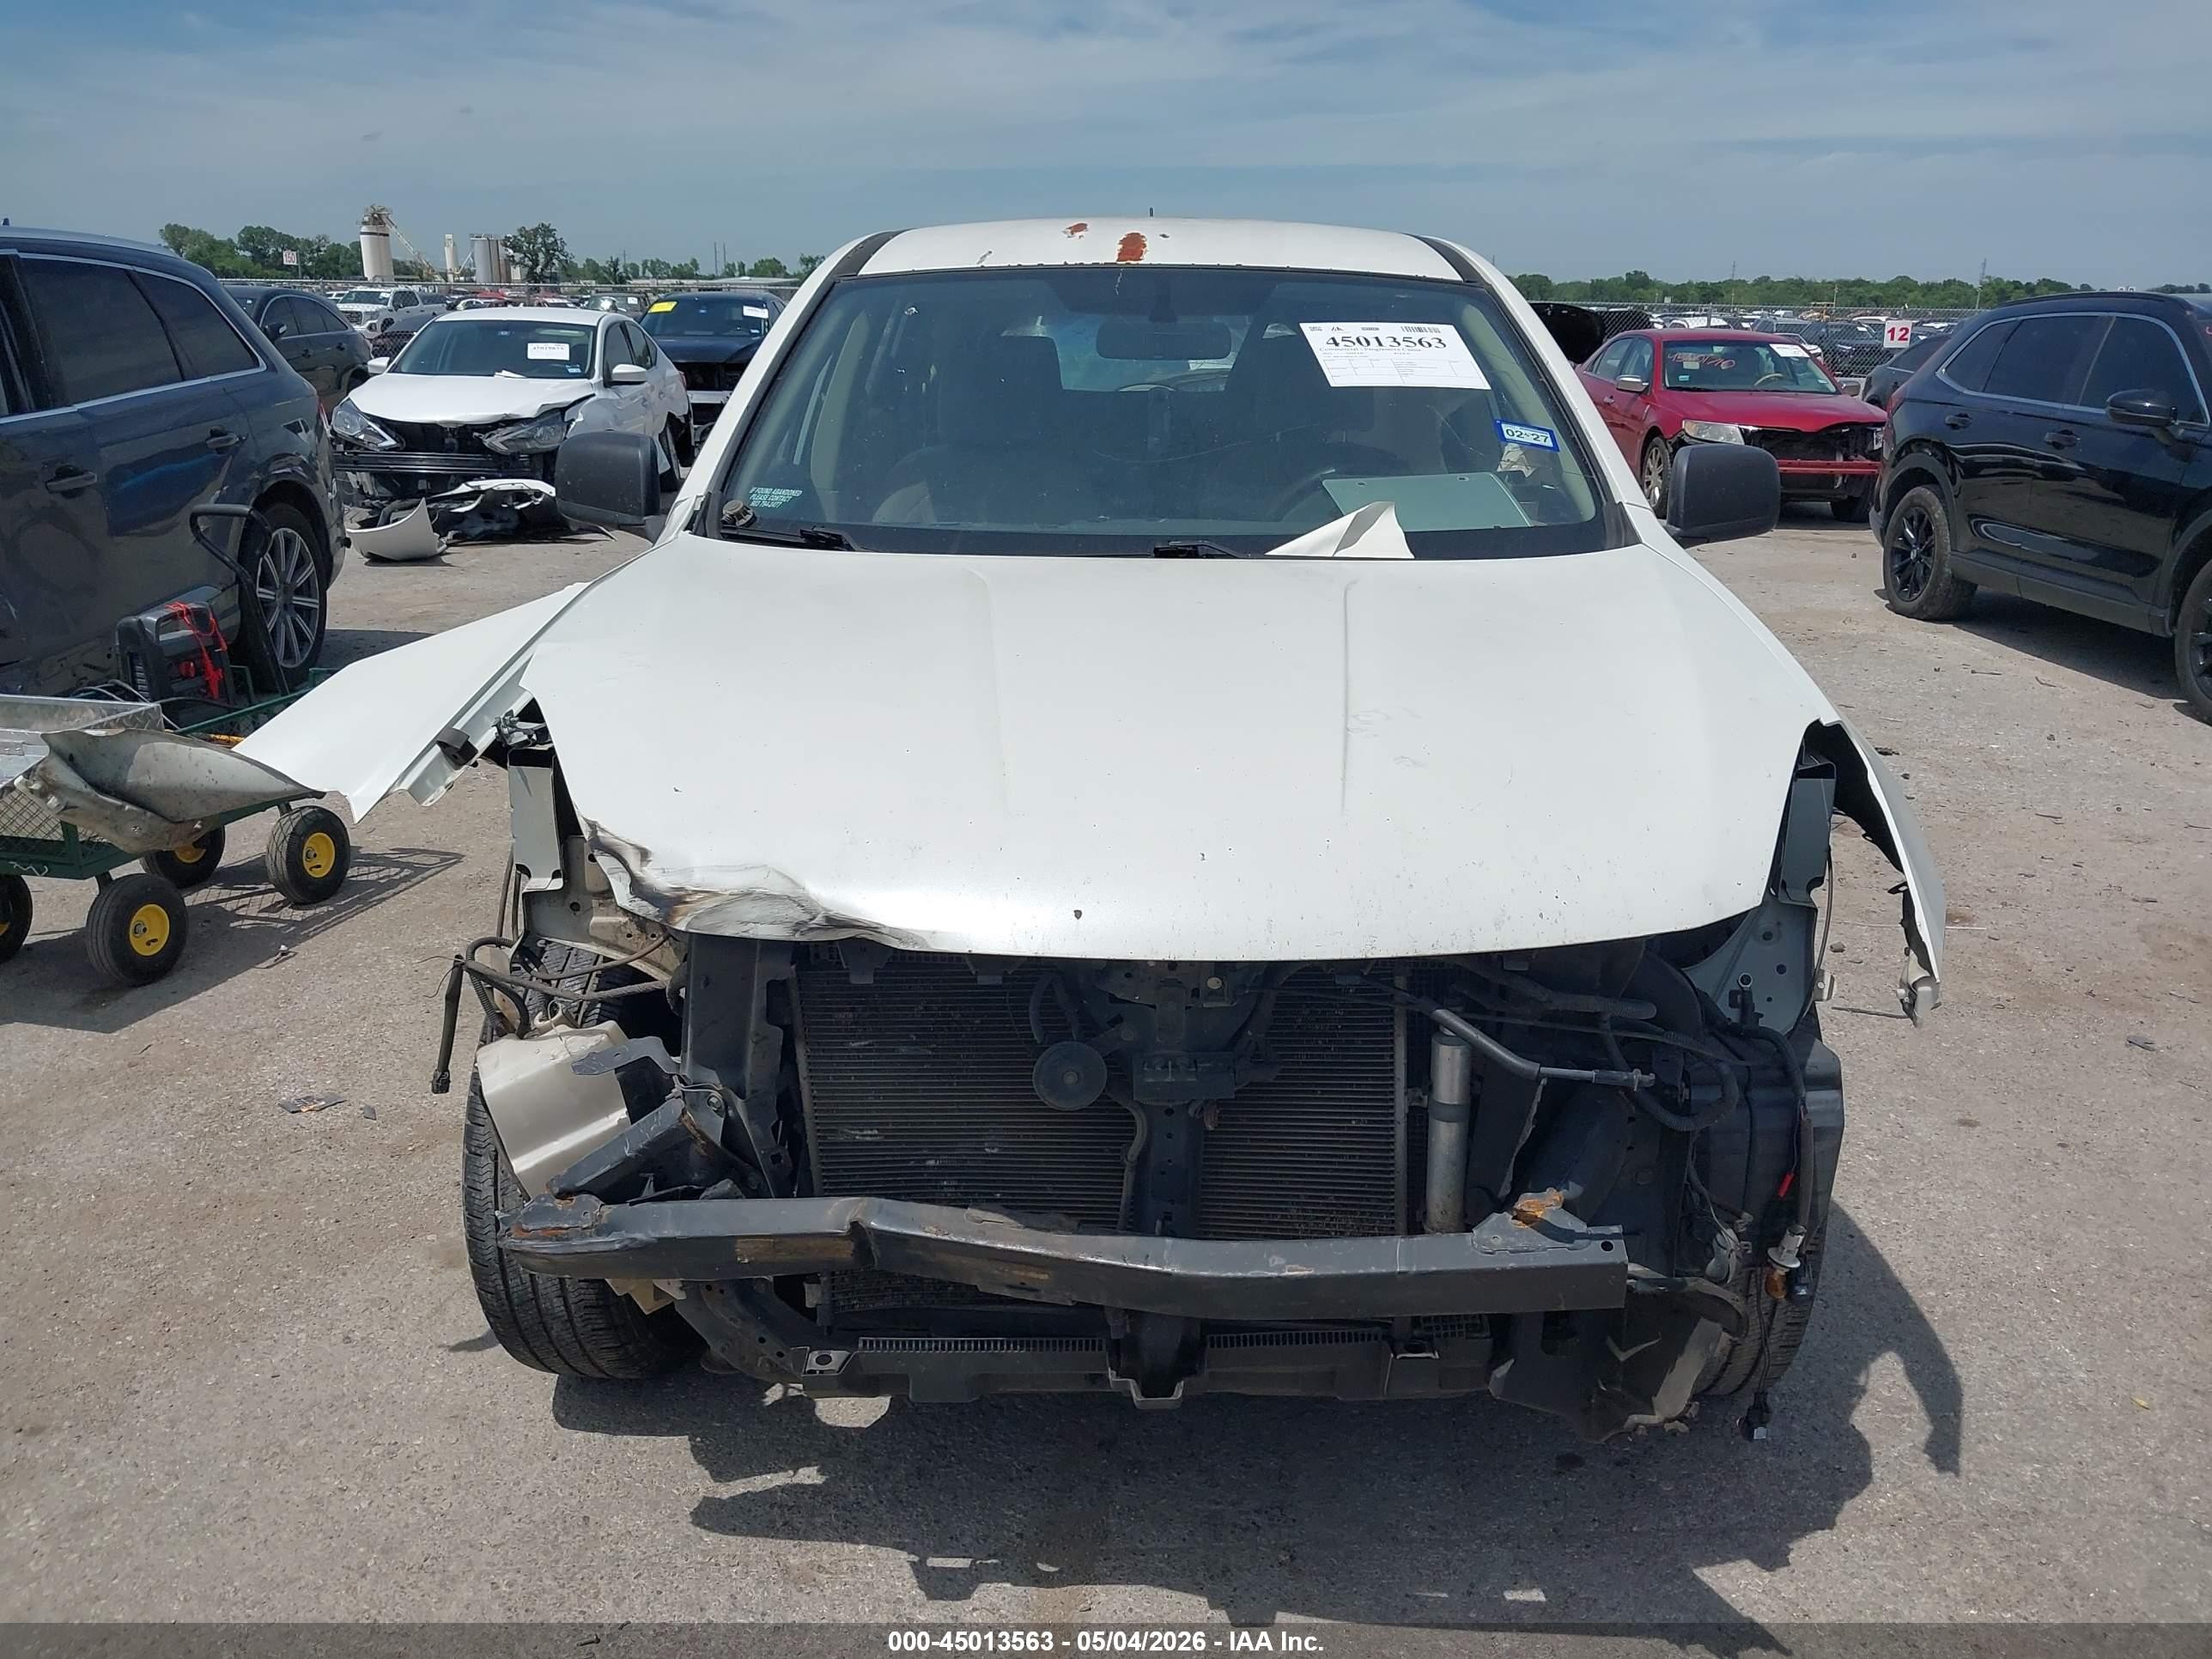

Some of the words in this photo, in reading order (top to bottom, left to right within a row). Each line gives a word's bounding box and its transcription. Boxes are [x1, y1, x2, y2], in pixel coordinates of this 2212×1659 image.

[1887, 326, 1910, 342] 12
[1326, 336, 1447, 349] 45013563
[771, 488, 803, 496] ABANDONED
